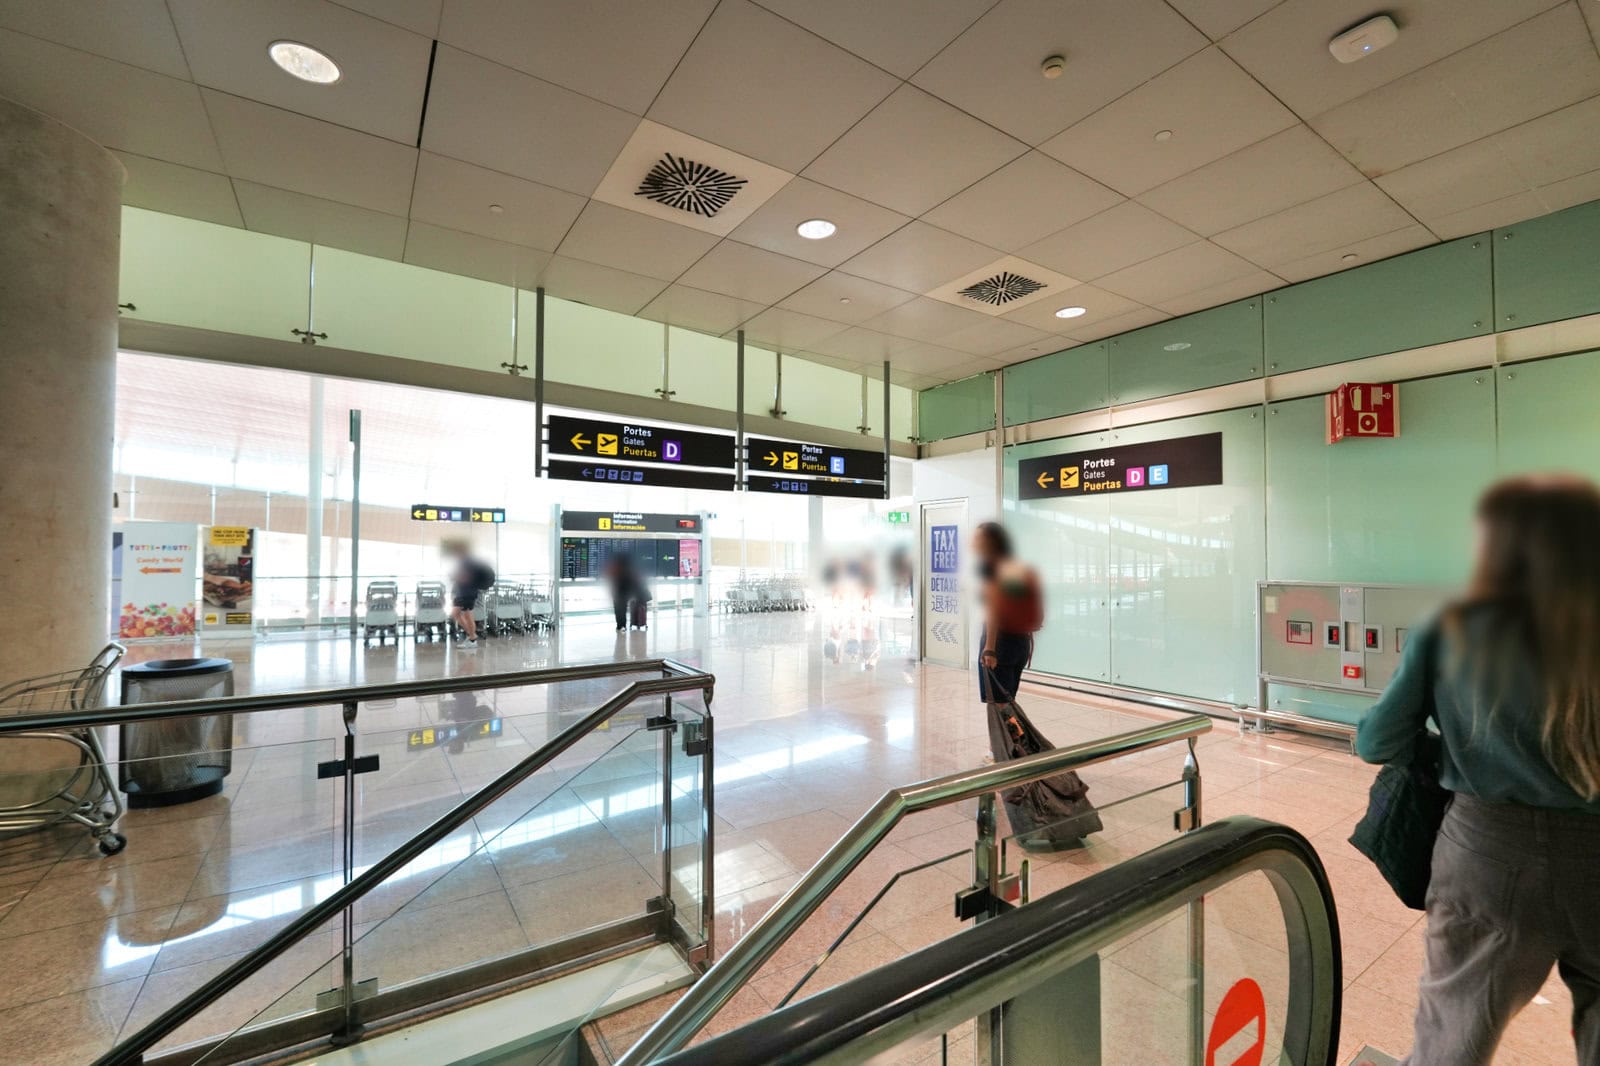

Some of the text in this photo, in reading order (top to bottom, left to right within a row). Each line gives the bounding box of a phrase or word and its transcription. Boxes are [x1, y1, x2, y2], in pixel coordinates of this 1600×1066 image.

[624, 426, 652, 437] Portes
[624, 437, 645, 446] Gates
[624, 447, 656, 457] Puertas
[666, 443, 678, 458] D
[802, 445, 822, 454] Portes
[802, 463, 826, 471] Puertas
[834, 459, 840, 472] E
[1084, 459, 1115, 469] Portes
[1084, 470, 1106, 479] Gates
[1131, 468, 1162, 483] D E
[1084, 480, 1121, 491] Puertas
[934, 530, 956, 550] TAX
[934, 552, 956, 568] FREE
